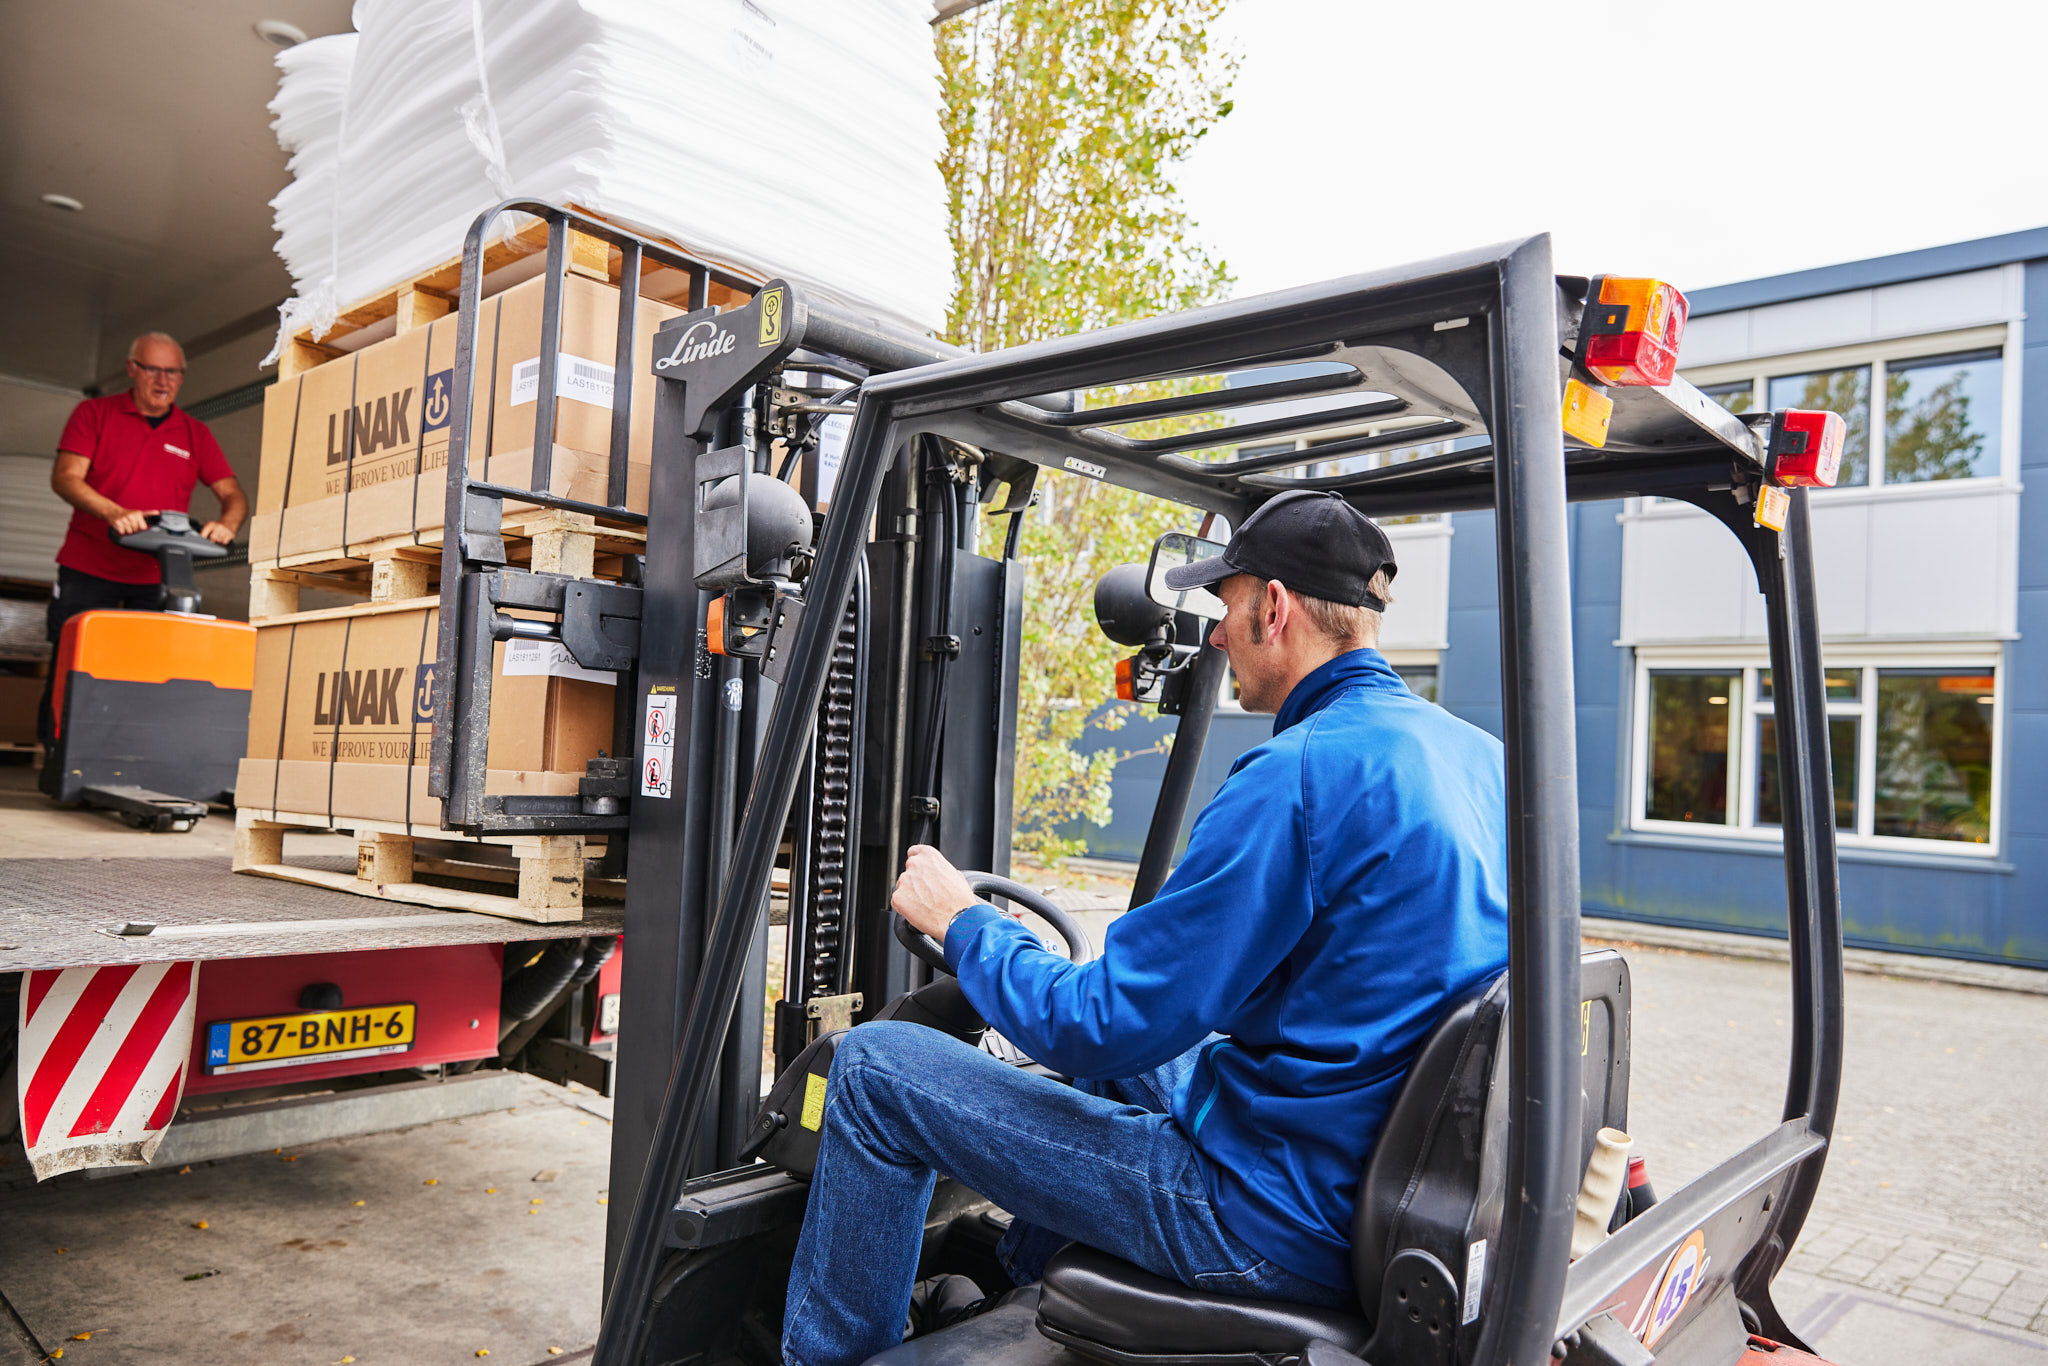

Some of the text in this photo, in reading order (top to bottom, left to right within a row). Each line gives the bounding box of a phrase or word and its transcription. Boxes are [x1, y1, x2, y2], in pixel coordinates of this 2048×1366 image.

[656, 321, 735, 369] Linde
[327, 387, 413, 467] LINAK
[326, 477, 341, 495] WE
[314, 667, 405, 725] LINAK
[312, 740, 327, 757] WE
[379, 741, 409, 759] YOUR
[211, 1049, 226, 1059] NL
[241, 1011, 404, 1056] 87-BNH-6
[1655, 1264, 1694, 1328] 45
